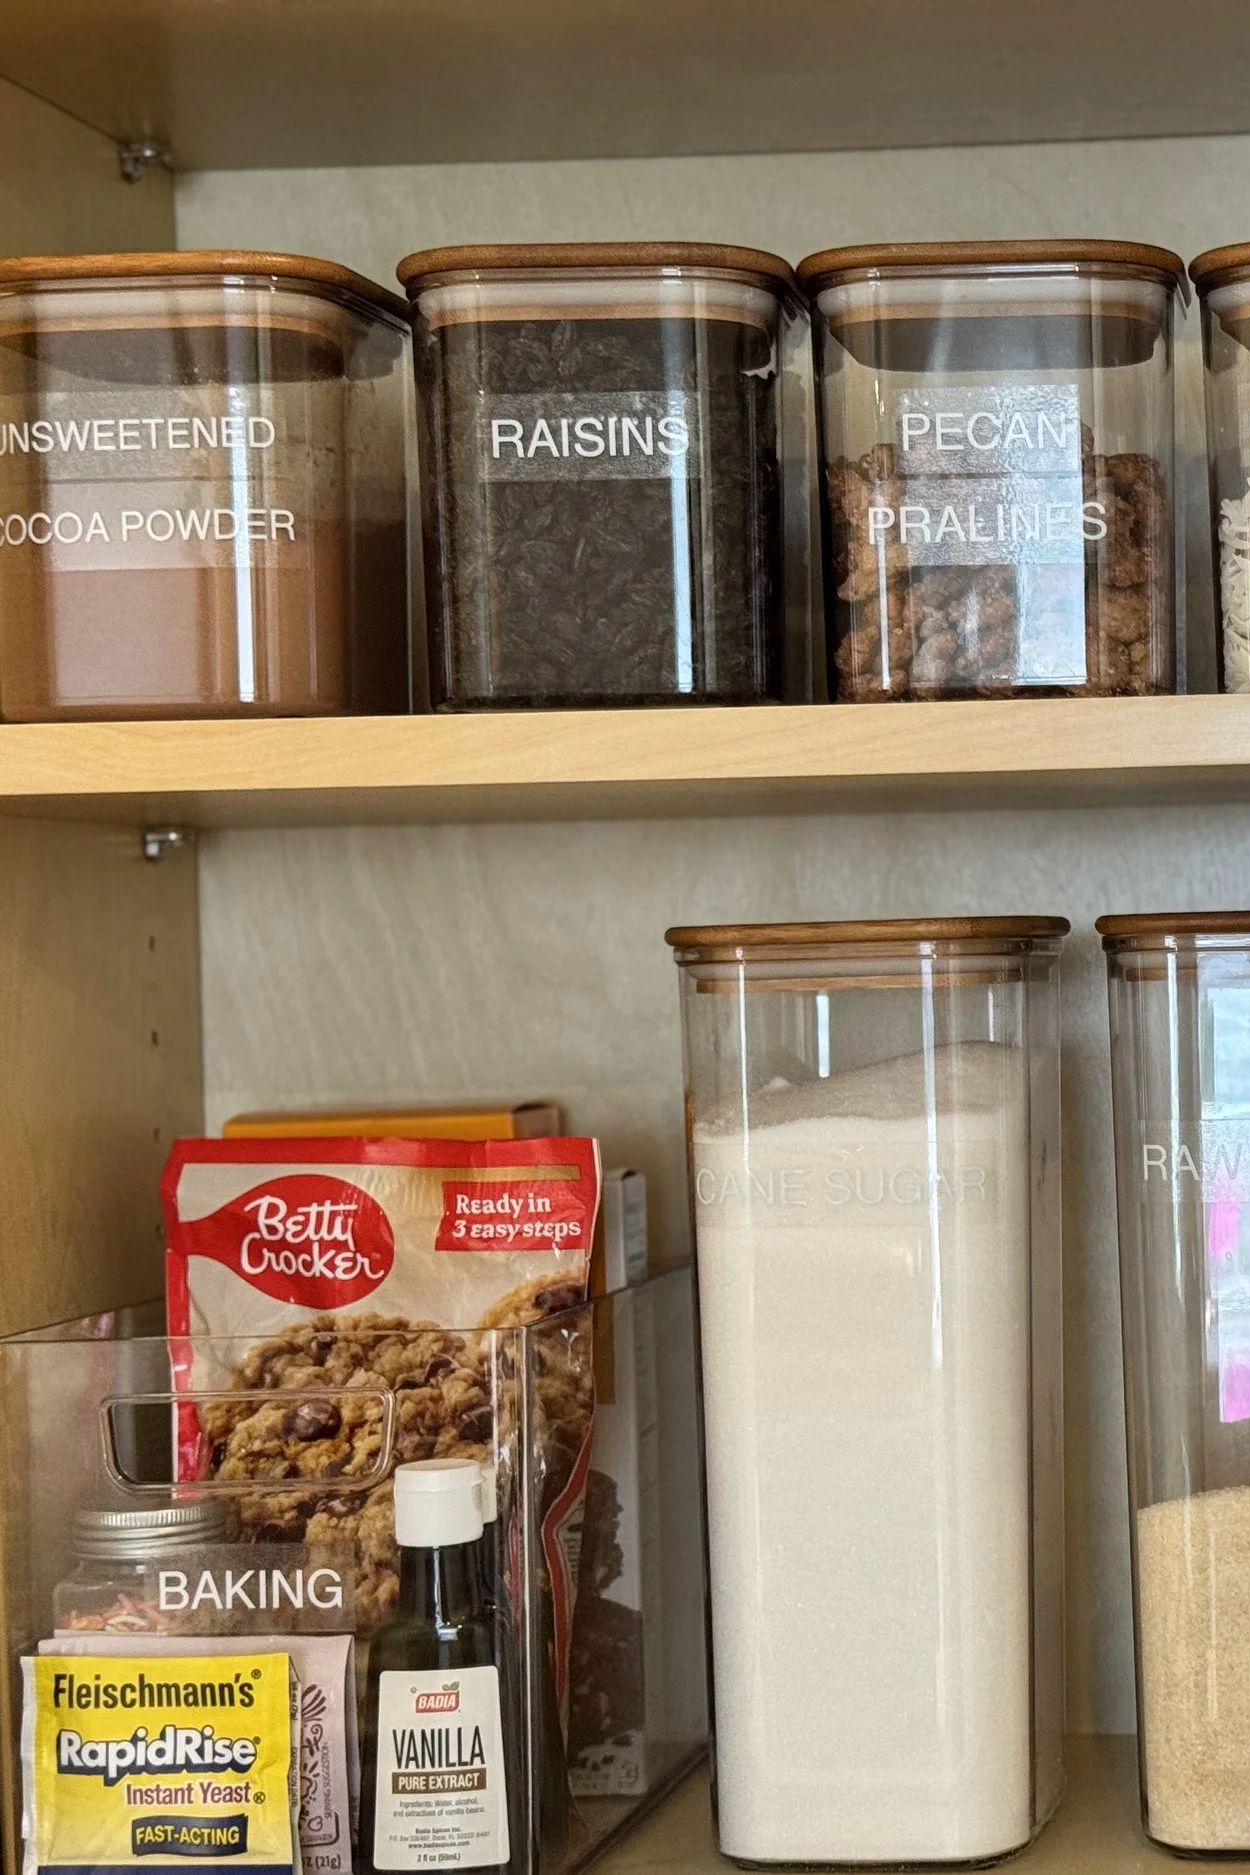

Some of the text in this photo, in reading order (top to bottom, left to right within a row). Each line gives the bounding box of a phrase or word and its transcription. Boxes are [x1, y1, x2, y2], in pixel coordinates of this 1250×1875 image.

[0, 416, 275, 455] NSWEETENED
[491, 415, 690, 459] RAISINS
[901, 411, 1068, 451] PECAN
[0, 508, 296, 546] OCOA POWDER
[867, 501, 1109, 546] PRALINES
[1142, 1141, 1245, 1182] RAW
[455, 1192, 552, 1220] Ready in
[695, 1166, 987, 1207] CANE SUGAR
[244, 1194, 358, 1251] Betty
[452, 1219, 582, 1244] 3 easy steps
[241, 1232, 385, 1281] Crocker
[158, 1568, 343, 1611] BAKING
[54, 1672, 255, 1709] Fleischmann's
[418, 1694, 457, 1710] BADIA
[57, 1725, 258, 1783] RapidRise
[392, 1725, 486, 1770] VANILLA
[126, 1781, 252, 1806] Instant Yeast
[398, 1772, 481, 1791] PURE EXTRACT
[135, 1825, 241, 1847] FAST-ACTING
[416, 1854, 423, 1863] 2
